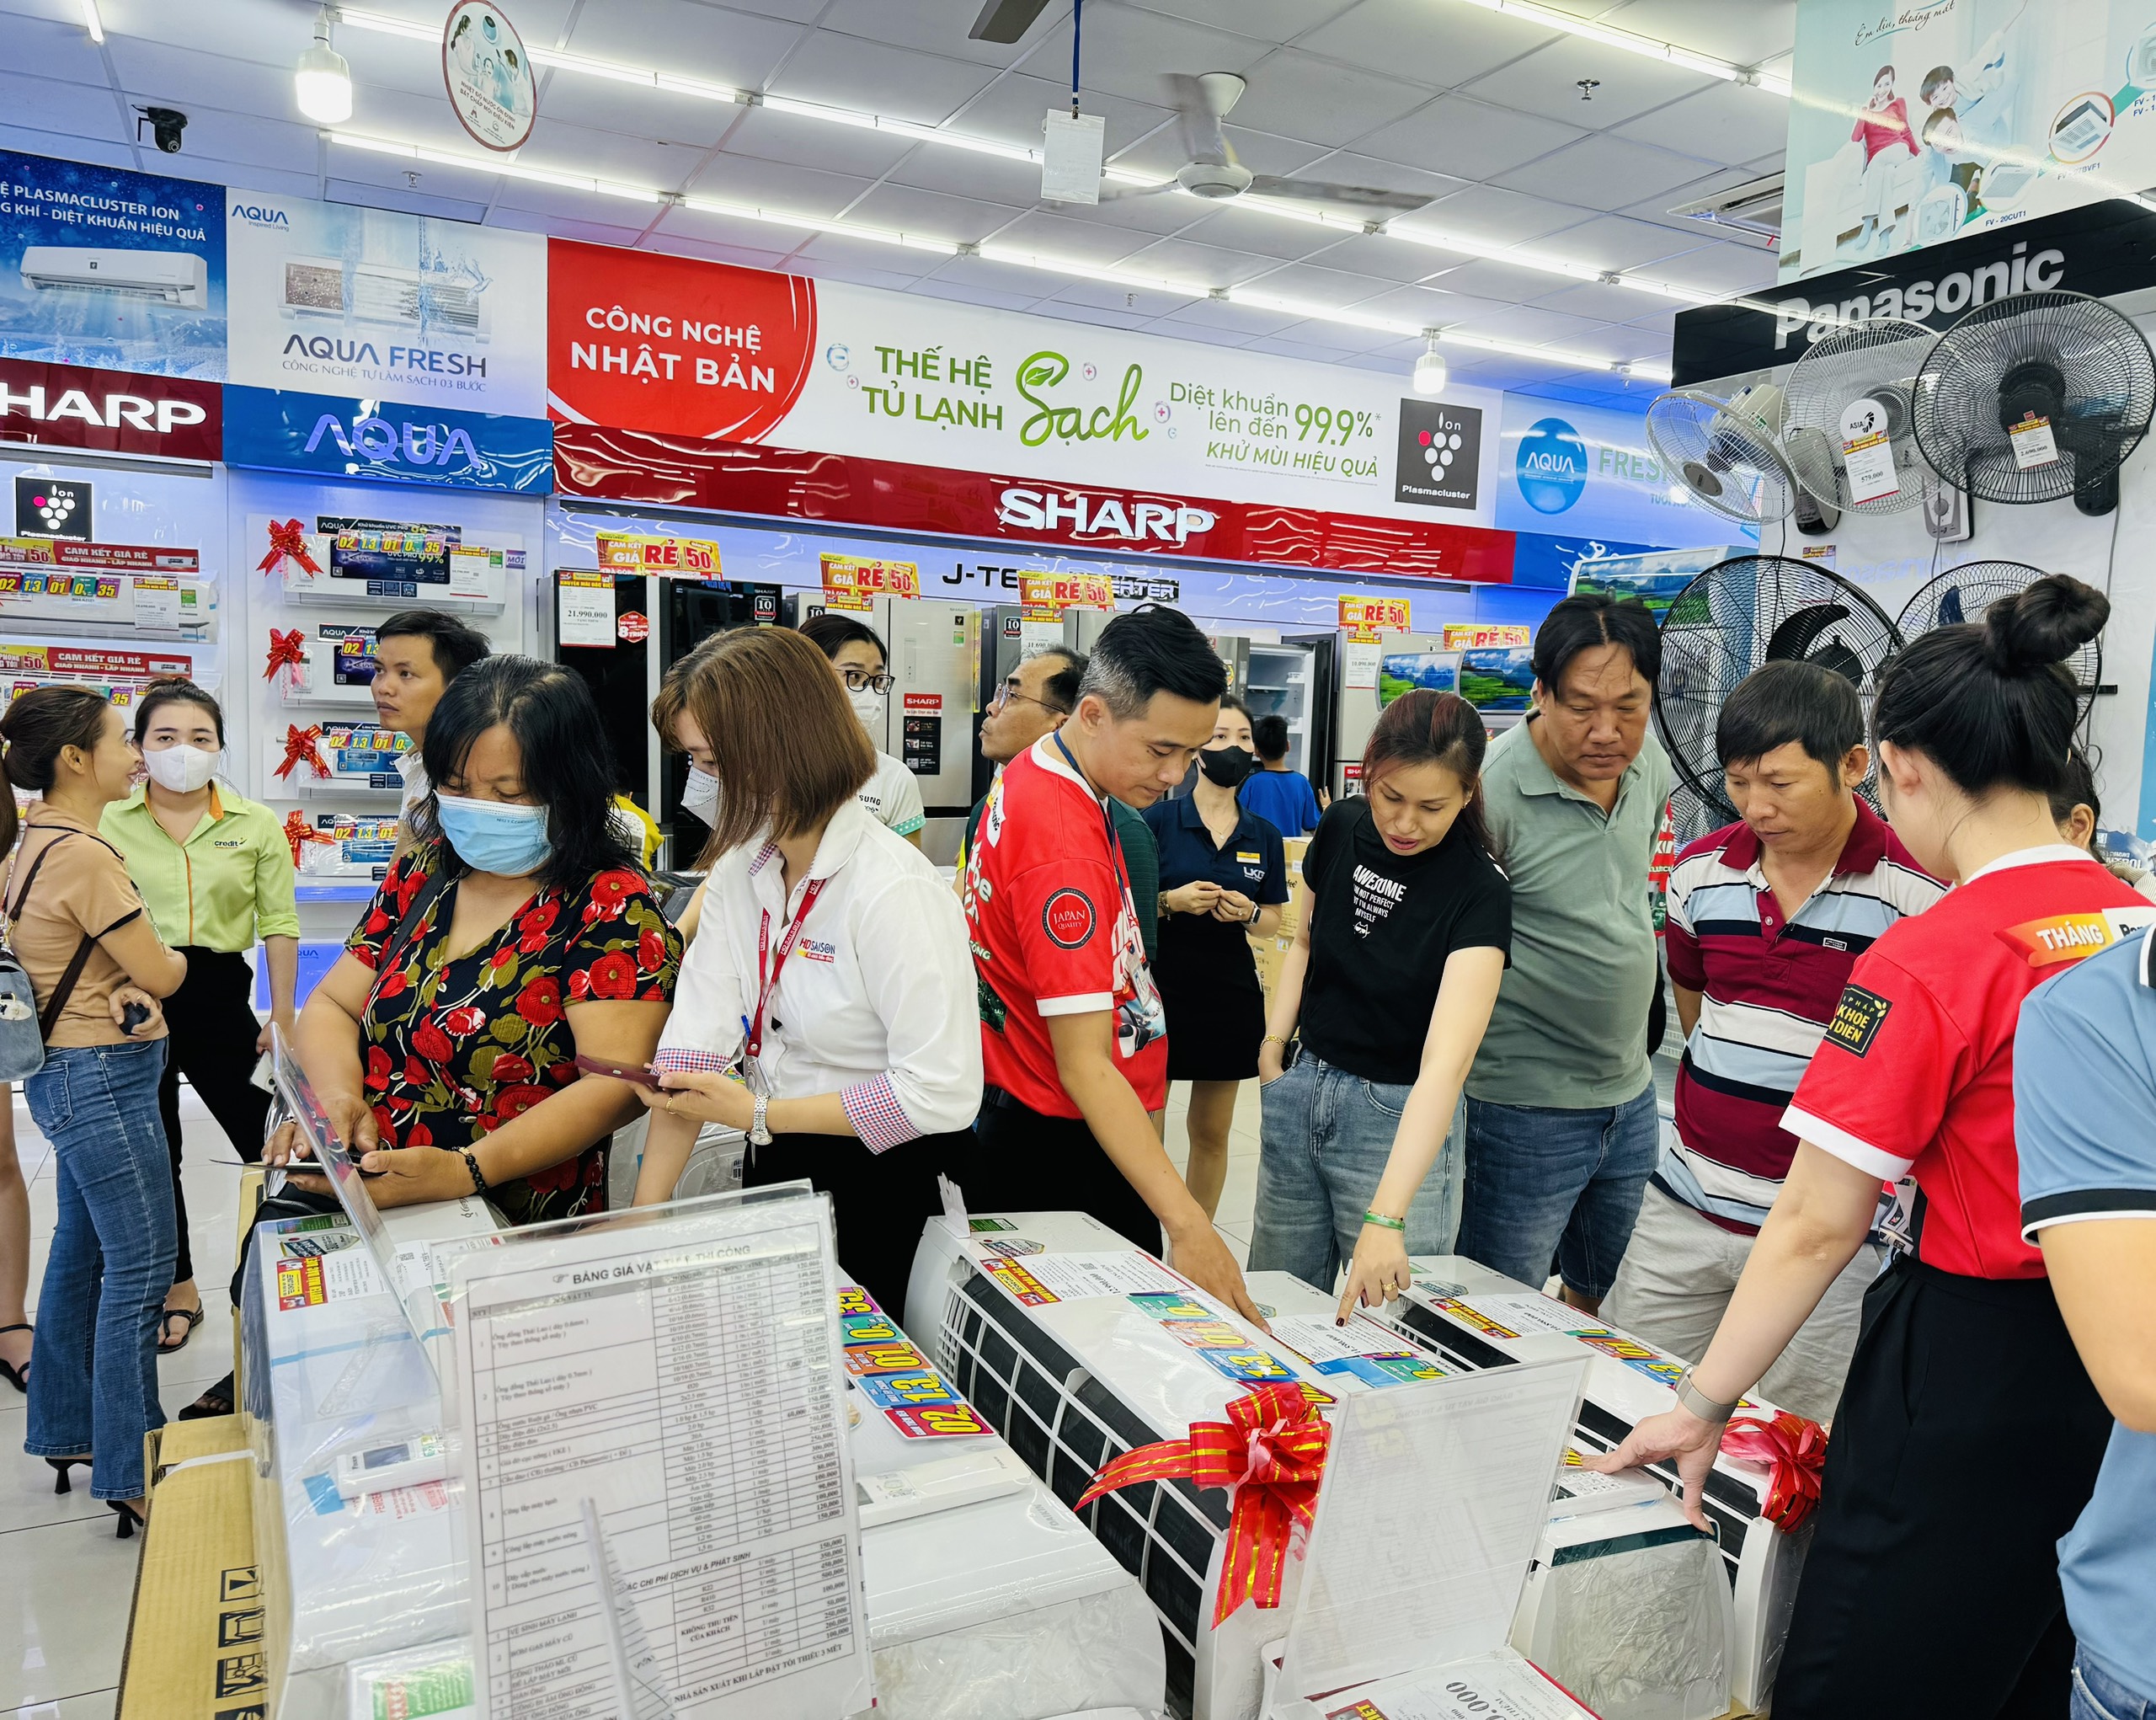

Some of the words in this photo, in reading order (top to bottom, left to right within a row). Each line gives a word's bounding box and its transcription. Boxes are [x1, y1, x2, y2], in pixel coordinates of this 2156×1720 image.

[2134, 99, 2145, 107] FV
[14, 185, 147, 216] PLASMACLUSTER
[152, 206, 179, 221] ION
[15, 204, 40, 217] KHÍ
[51, 210, 84, 225] DIỆT
[88, 215, 137, 232] KHUẨN
[141, 222, 173, 238] HIỆU
[176, 227, 206, 242] QUẢ
[232, 205, 289, 225] AQUA
[248, 221, 271, 229] Inspired
[1986, 218, 1997, 227] FV
[1774, 241, 2066, 350] Panasonic
[585, 305, 672, 339] CÔNG
[682, 321, 761, 352] NGHỆ
[283, 334, 380, 366] AQUA
[389, 346, 487, 378] FRESH
[571, 340, 681, 385] NHẬT
[696, 354, 775, 394] BẢN
[283, 359, 318, 373] CÔNG
[322, 364, 357, 379] NGHỆ
[361, 369, 376, 382] TỰ
[380, 368, 403, 383] LÀM
[406, 375, 437, 389] SẠCH
[440, 378, 453, 388] 03
[456, 379, 487, 393] BƯỚC
[874, 345, 942, 382] THẾ
[949, 355, 992, 395] HỆ
[862, 382, 905, 418] TỦ
[915, 398, 1003, 431] LẠNH
[1015, 350, 1150, 447] Sạch
[1170, 382, 1215, 408] Diệt
[1223, 387, 1289, 418] khuẩn
[1209, 409, 1242, 434] lên
[1247, 412, 1288, 441] đến
[304, 414, 483, 470] AQUA
[1207, 440, 1250, 462] KHỬ
[1253, 446, 1289, 468] MÙI
[1294, 451, 1338, 475] HIỆU
[1342, 455, 1379, 478] QUẢ
[1525, 451, 1575, 473] AQUA
[1599, 447, 1674, 483] FRES
[1402, 485, 1471, 500] Plasmacluster
[1000, 488, 1215, 543] SHARP
[65, 548, 88, 556] CAM
[114, 549, 131, 558] GIÁ
[339, 539, 355, 549] 02
[383, 540, 398, 550] 01
[425, 542, 440, 553] 35
[613, 550, 640, 564] GIÁ
[644, 539, 679, 565] RẺ
[686, 548, 712, 569] 50
[628, 540, 643, 549] KẾT
[834, 574, 854, 585] GIÁ
[857, 561, 885, 587] RẺ
[942, 564, 1020, 589] J-TE
[98, 585, 115, 596] 35
[1031, 588, 1052, 599] GIÁ
[1054, 576, 1081, 600] RẺ
[1112, 580, 1175, 599] ERTER
[568, 610, 607, 619] 21.990.000
[757, 600, 772, 611] 10
[1347, 612, 1363, 621] GIÁ
[1364, 600, 1385, 622] RẺ
[1390, 606, 1404, 623] 50
[618, 626, 629, 638] 8
[1006, 620, 1019, 629] 10
[344, 643, 360, 654] 02
[1454, 638, 1472, 649] GIÁ
[1476, 627, 1499, 647] RẺ
[59, 653, 83, 661] CAM
[85, 653, 104, 664] KẾT
[107, 655, 125, 664] GIÁ
[112, 693, 129, 705] 35
[374, 738, 389, 749] 01
[335, 828, 351, 839] 02
[1353, 864, 1406, 902] AWESOME
[1366, 902, 1389, 918] ALWAYS
[1369, 893, 1395, 910] PERFECT
[1053, 910, 1086, 925] JAPAN
[1058, 921, 1082, 930] QUALITY
[1355, 908, 1376, 923] MYSELF
[2036, 921, 2104, 949] THÁNG
[573, 1268, 608, 1285] BẢNG
[612, 1263, 633, 1278] GIÁ
[866, 1349, 921, 1367] 01
[891, 1378, 952, 1402] 1.3
[920, 1410, 982, 1433] 02
[732, 1552, 751, 1563] SINH
